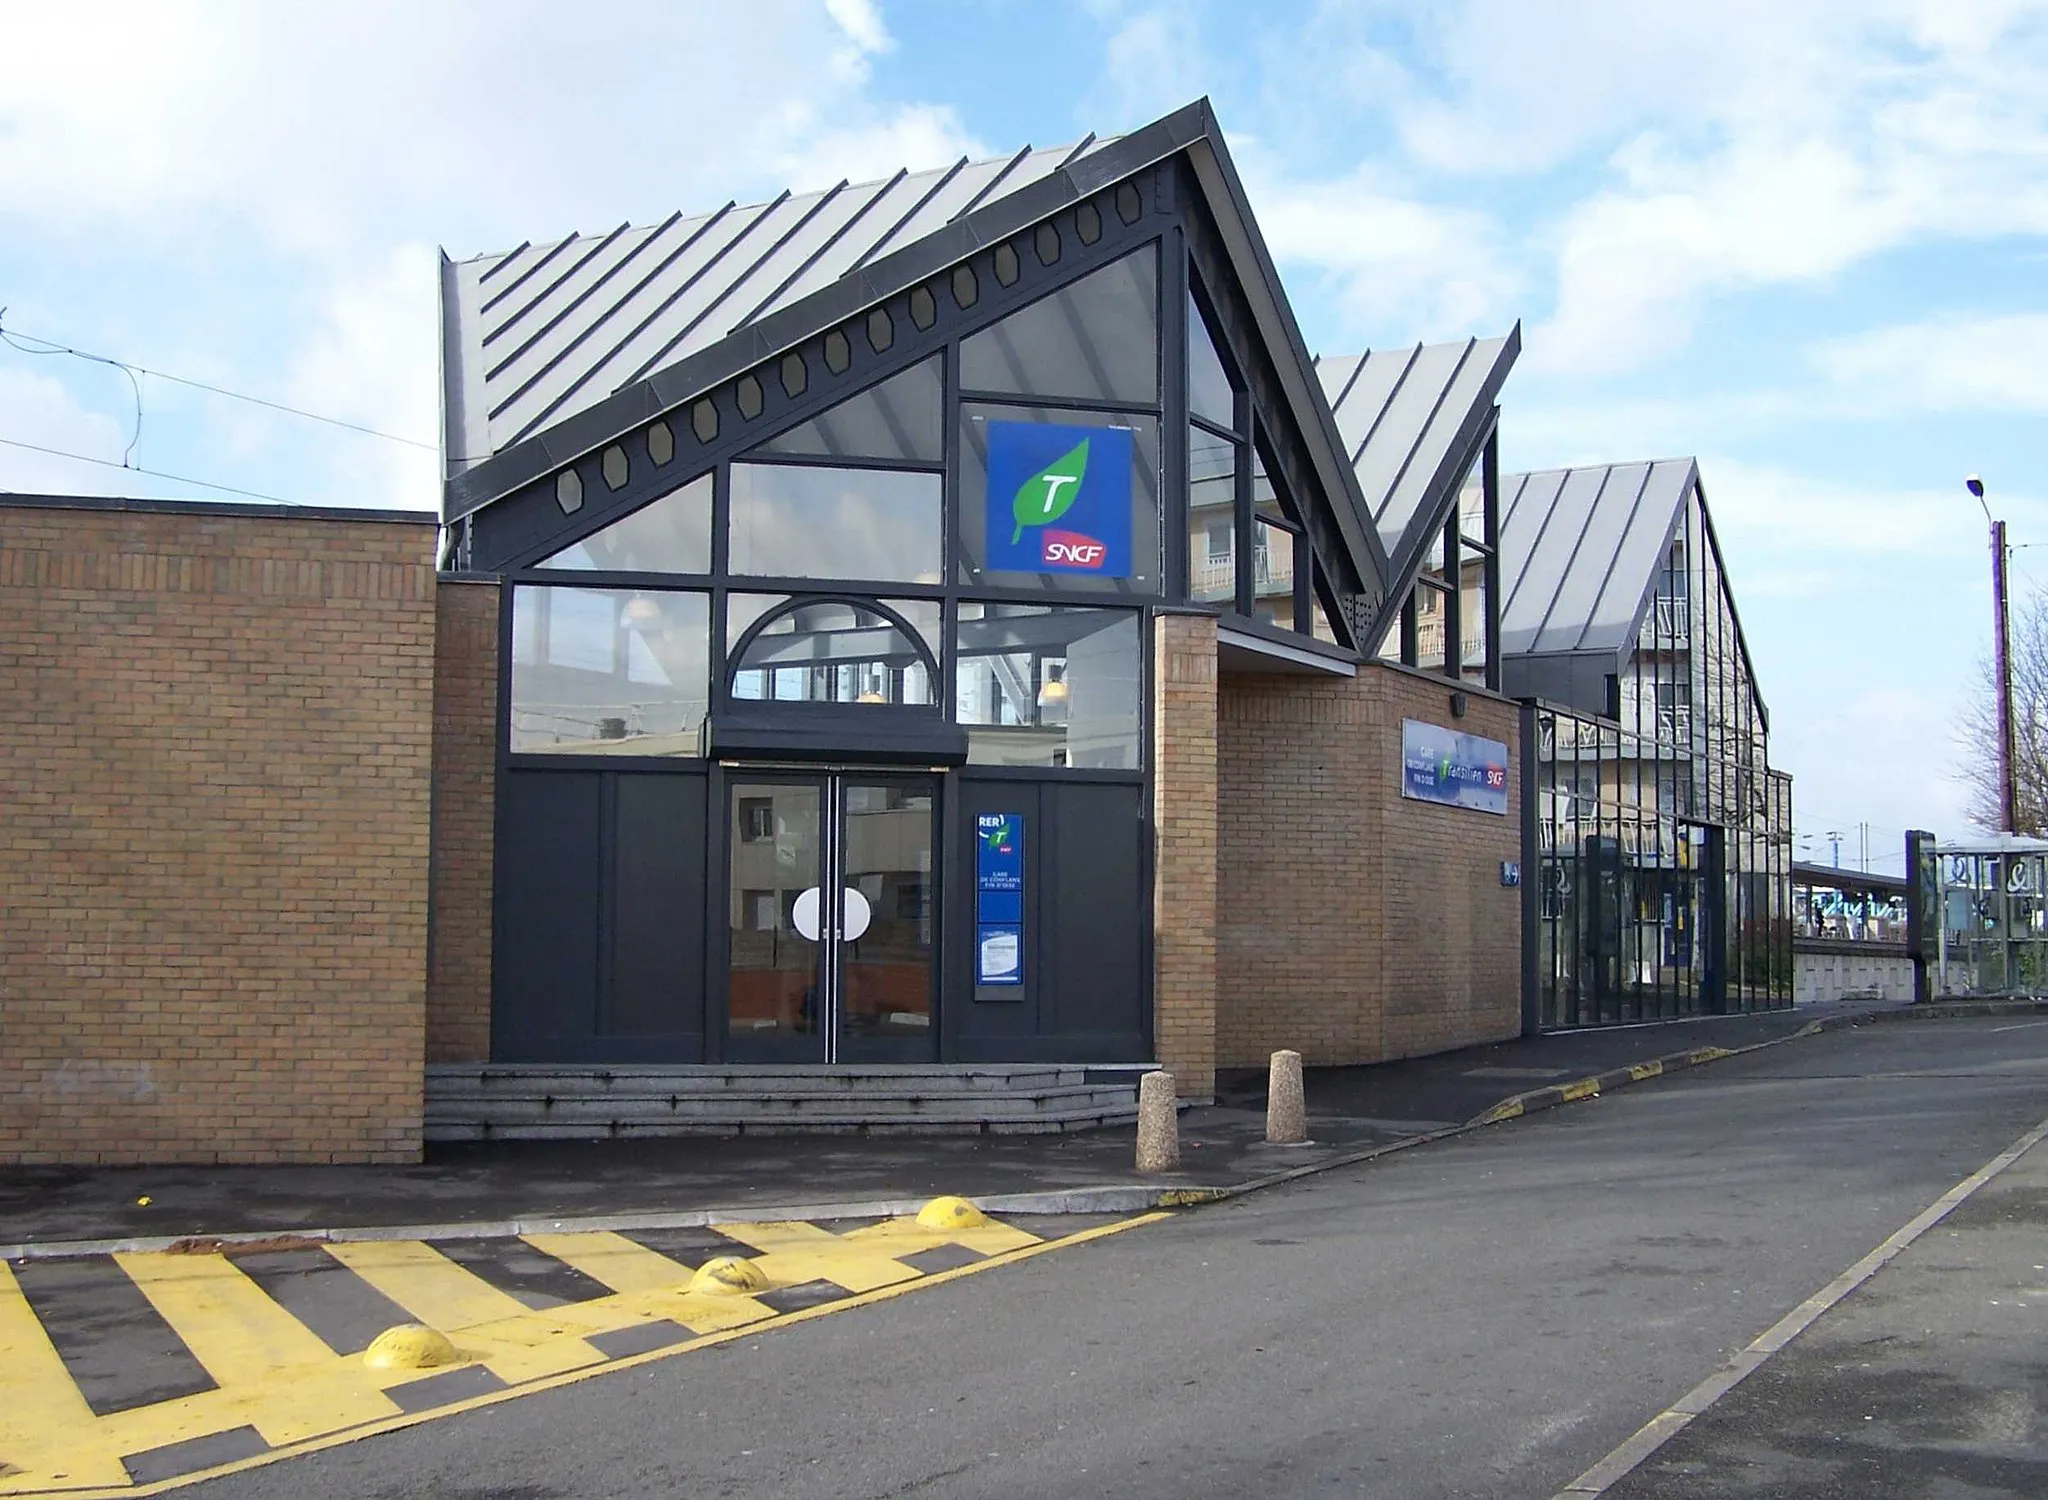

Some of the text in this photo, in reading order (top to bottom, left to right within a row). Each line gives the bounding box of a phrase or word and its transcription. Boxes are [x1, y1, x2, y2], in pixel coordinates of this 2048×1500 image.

[1042, 475, 1078, 513] T
[1045, 543, 1104, 563] SNCF
[979, 816, 1000, 827] RER
